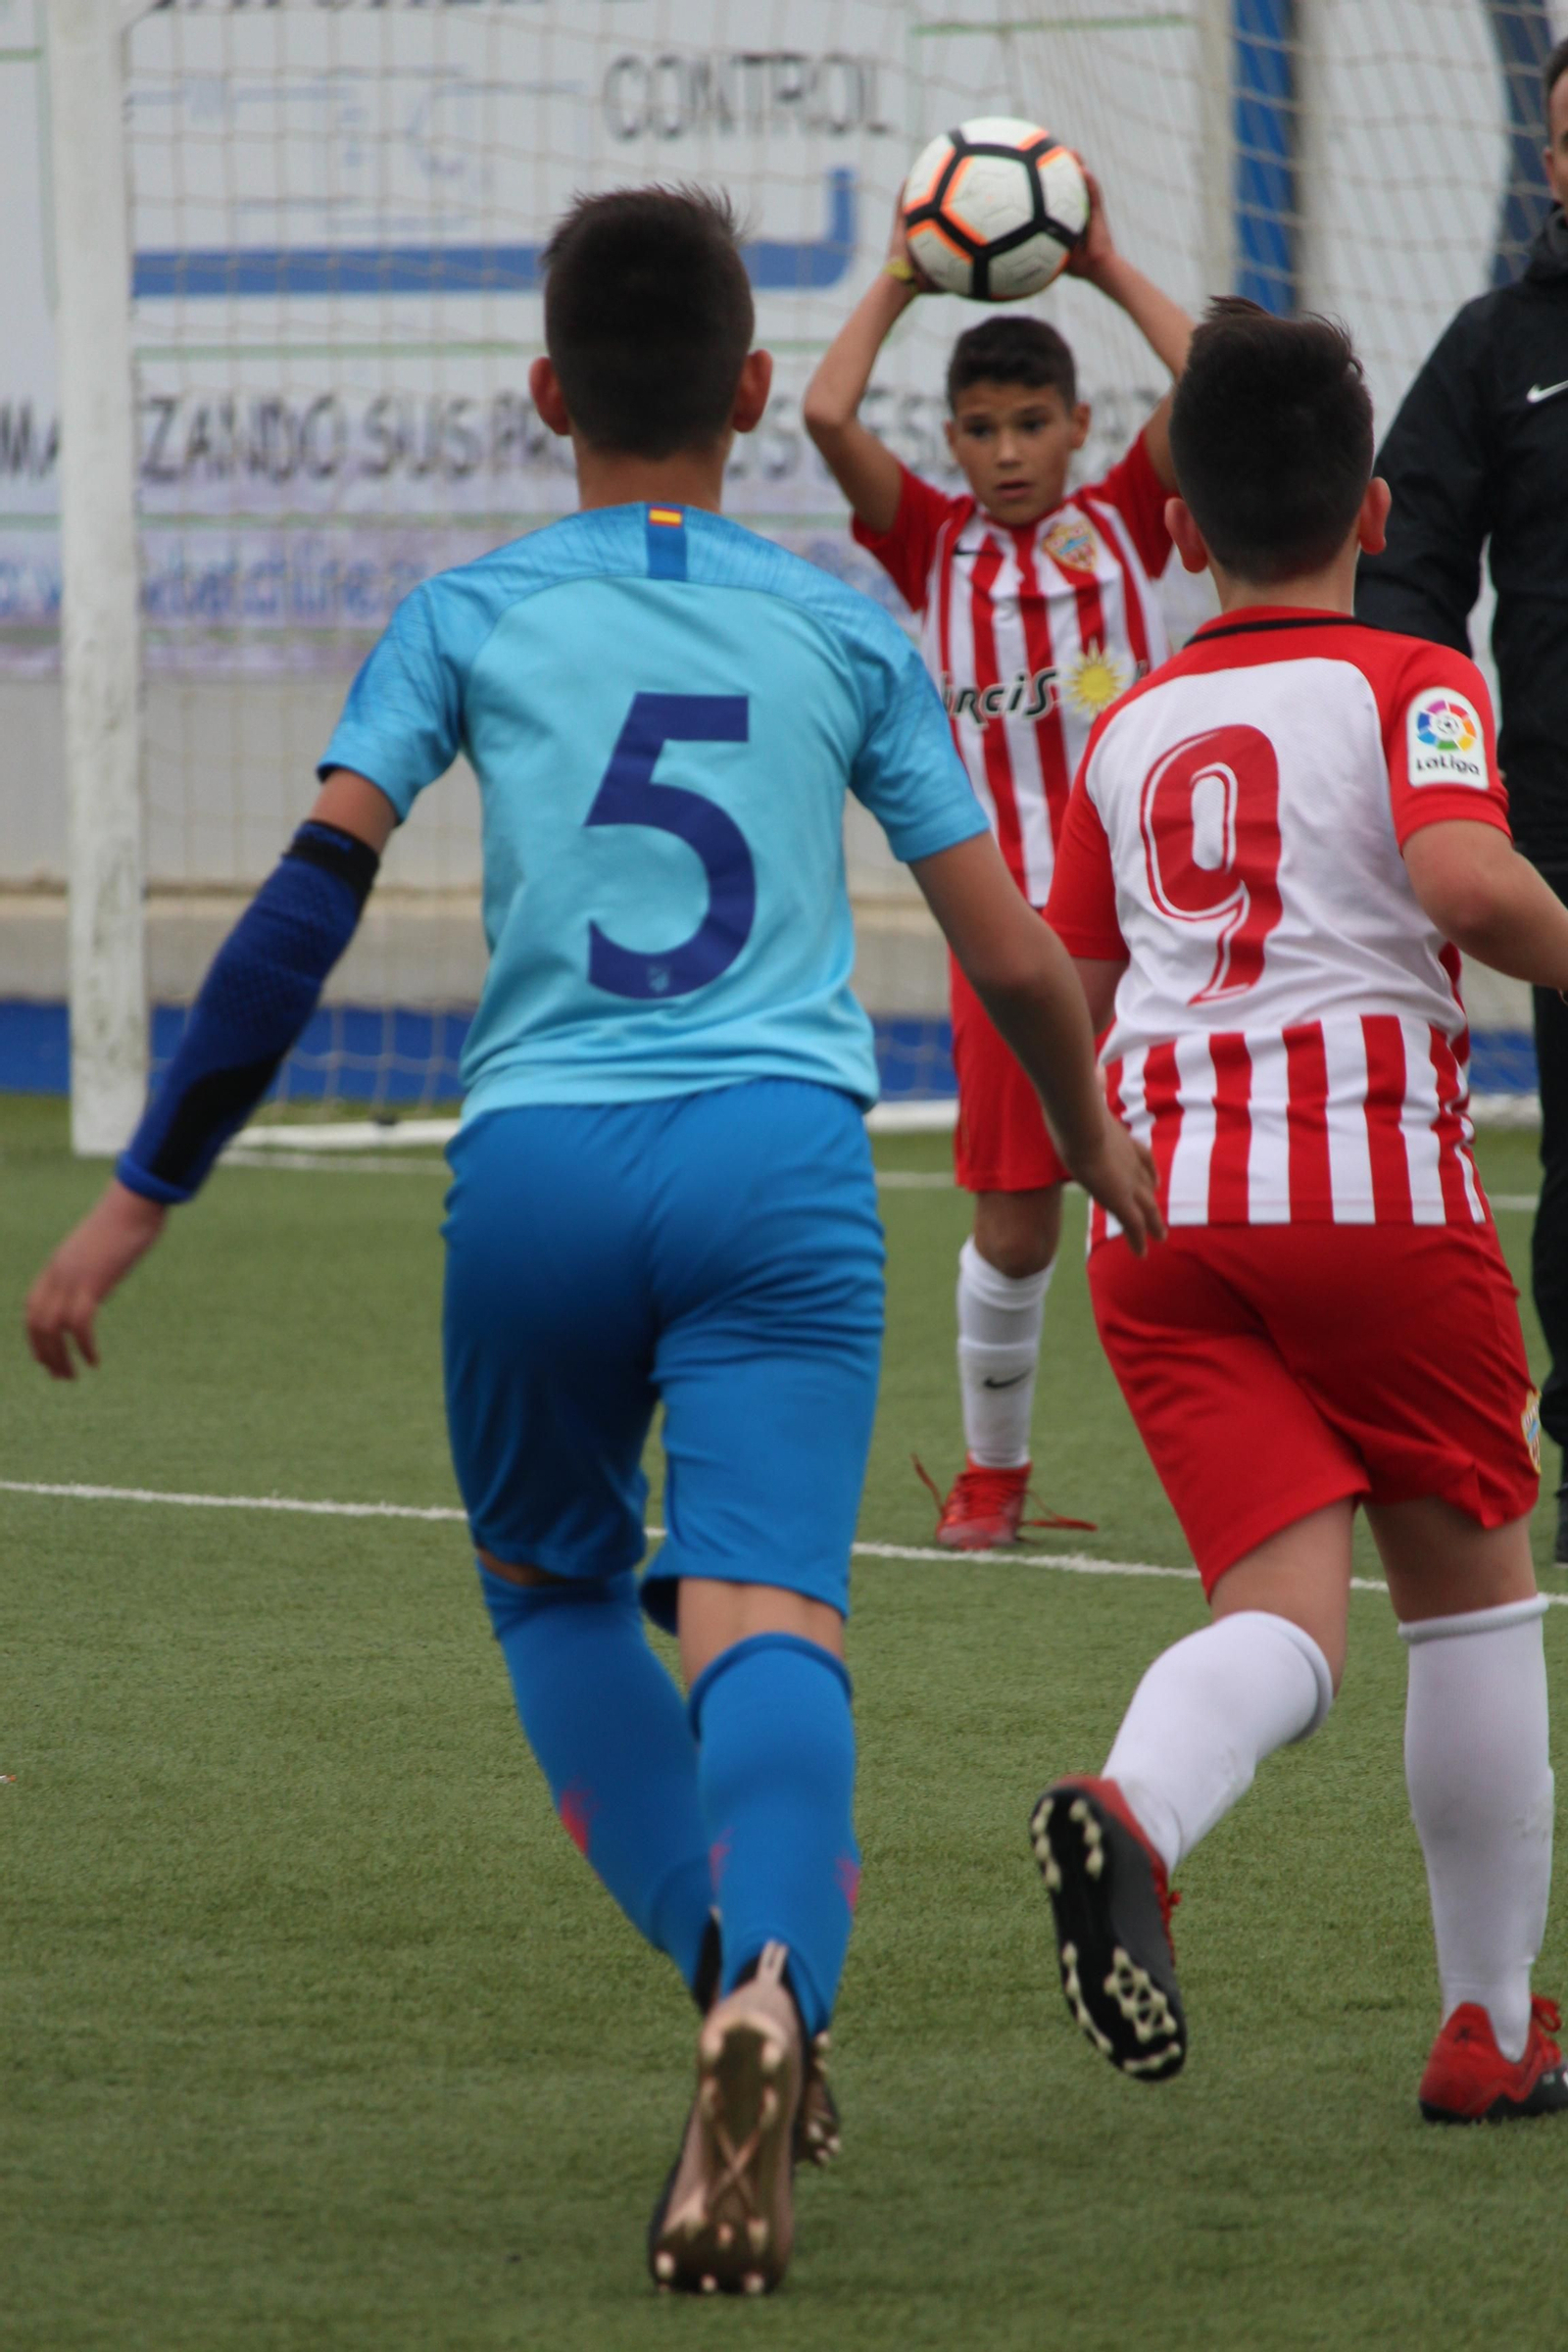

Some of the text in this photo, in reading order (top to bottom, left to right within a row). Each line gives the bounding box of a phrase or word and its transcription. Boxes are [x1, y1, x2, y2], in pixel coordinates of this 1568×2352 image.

[601, 53, 892, 139] CONTROL
[584, 692, 755, 998] 5
[1140, 723, 1282, 1006] 9
